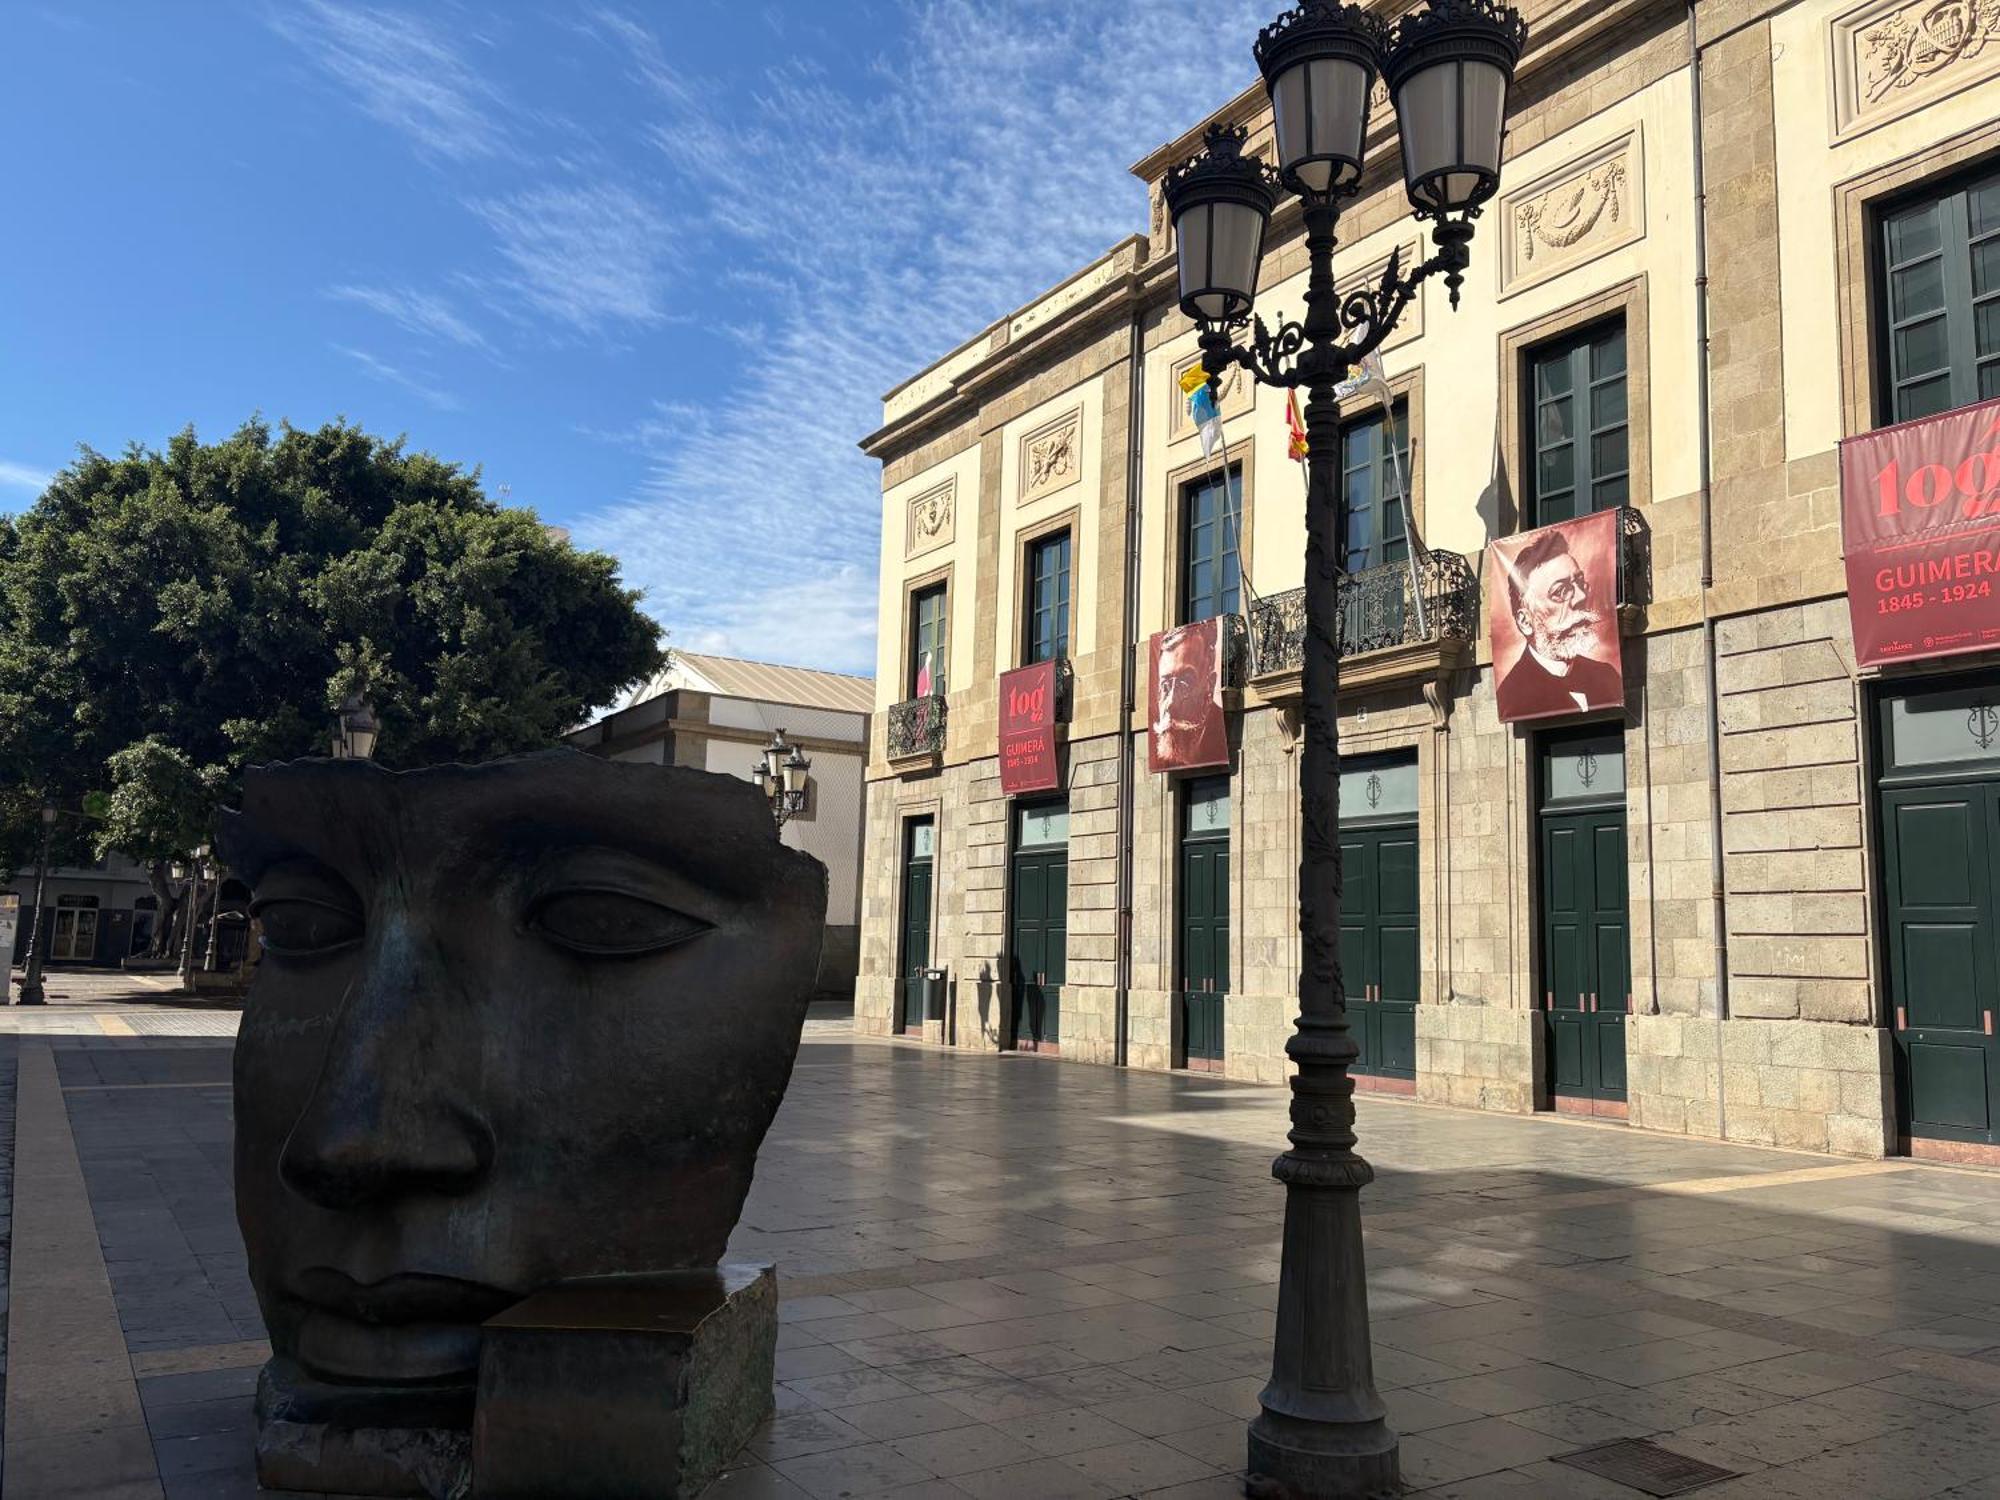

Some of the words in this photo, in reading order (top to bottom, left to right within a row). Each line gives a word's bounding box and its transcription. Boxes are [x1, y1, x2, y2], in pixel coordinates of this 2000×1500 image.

[1875, 549, 2000, 592] GUIMER
[1877, 592, 1924, 614] 1845
[1941, 580, 1991, 604] 1924
